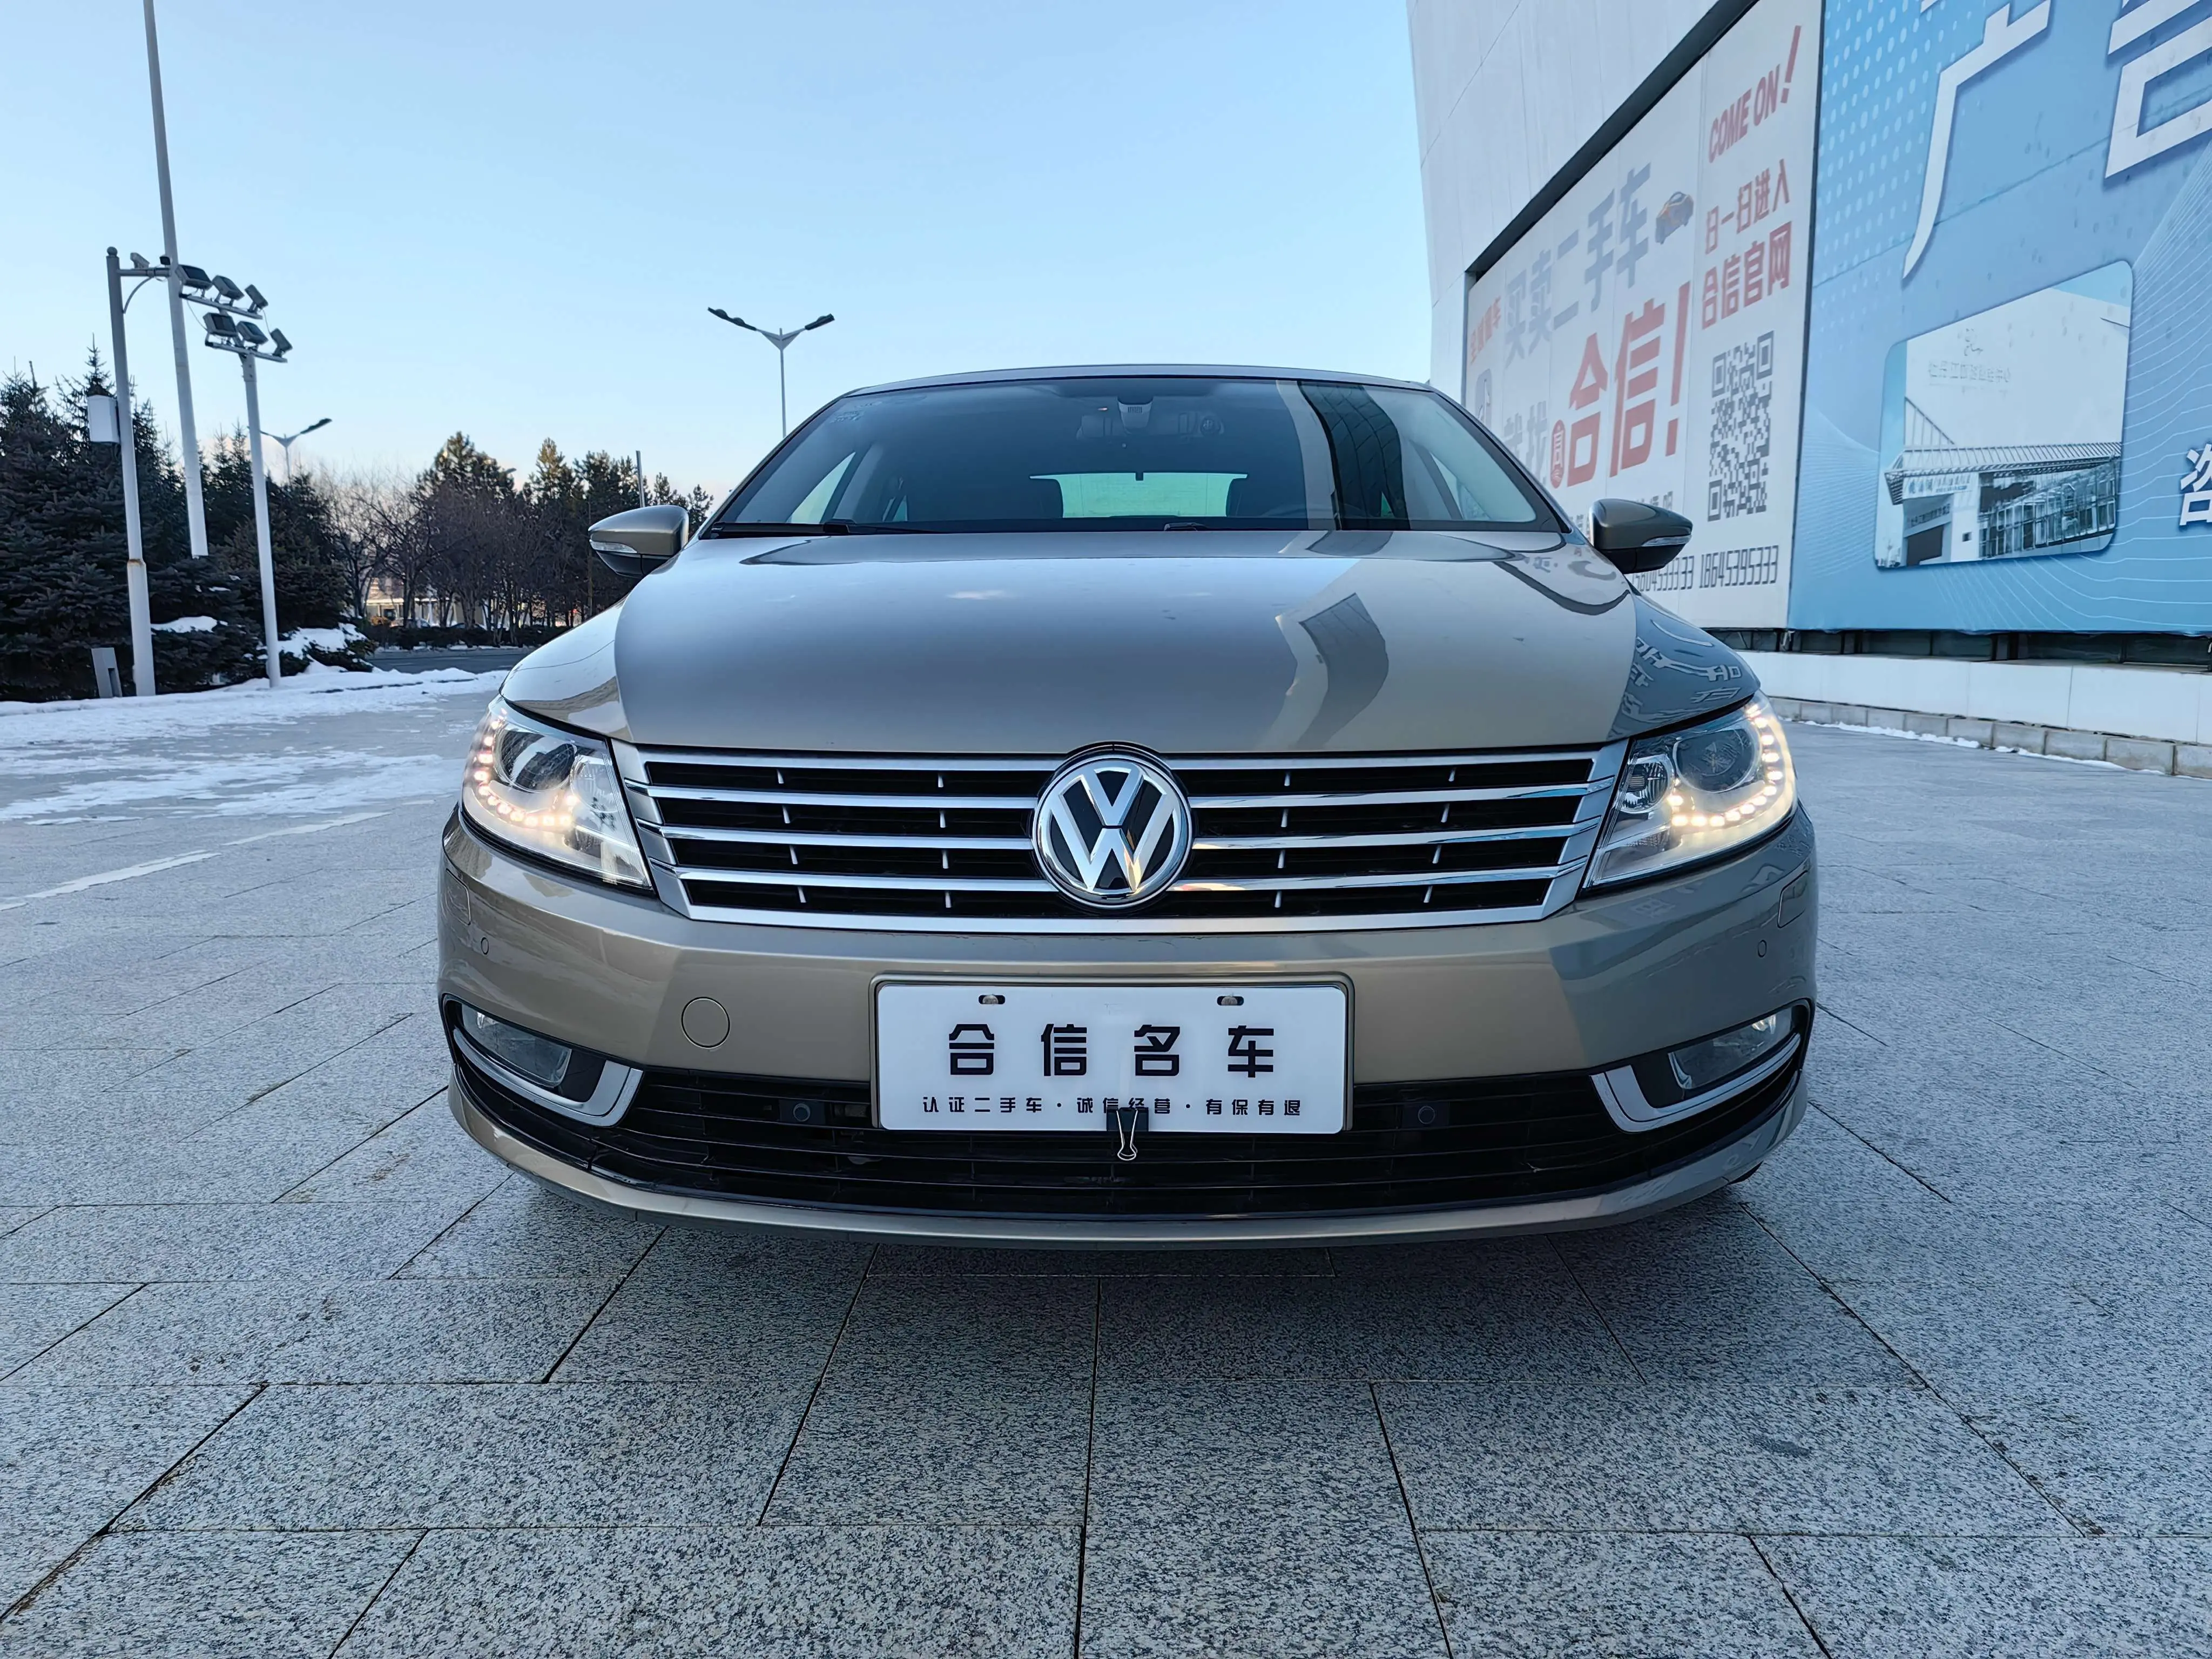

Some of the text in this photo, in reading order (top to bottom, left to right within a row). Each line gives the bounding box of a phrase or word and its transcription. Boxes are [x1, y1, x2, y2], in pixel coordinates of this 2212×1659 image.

[1709, 87, 1752, 163] COME
[1505, 162, 1651, 369] 买卖二手车
[1702, 221, 1792, 330] 合信官网
[1699, 545, 1779, 589] 18645395333
[948, 1023, 1274, 1078] 合信名车
